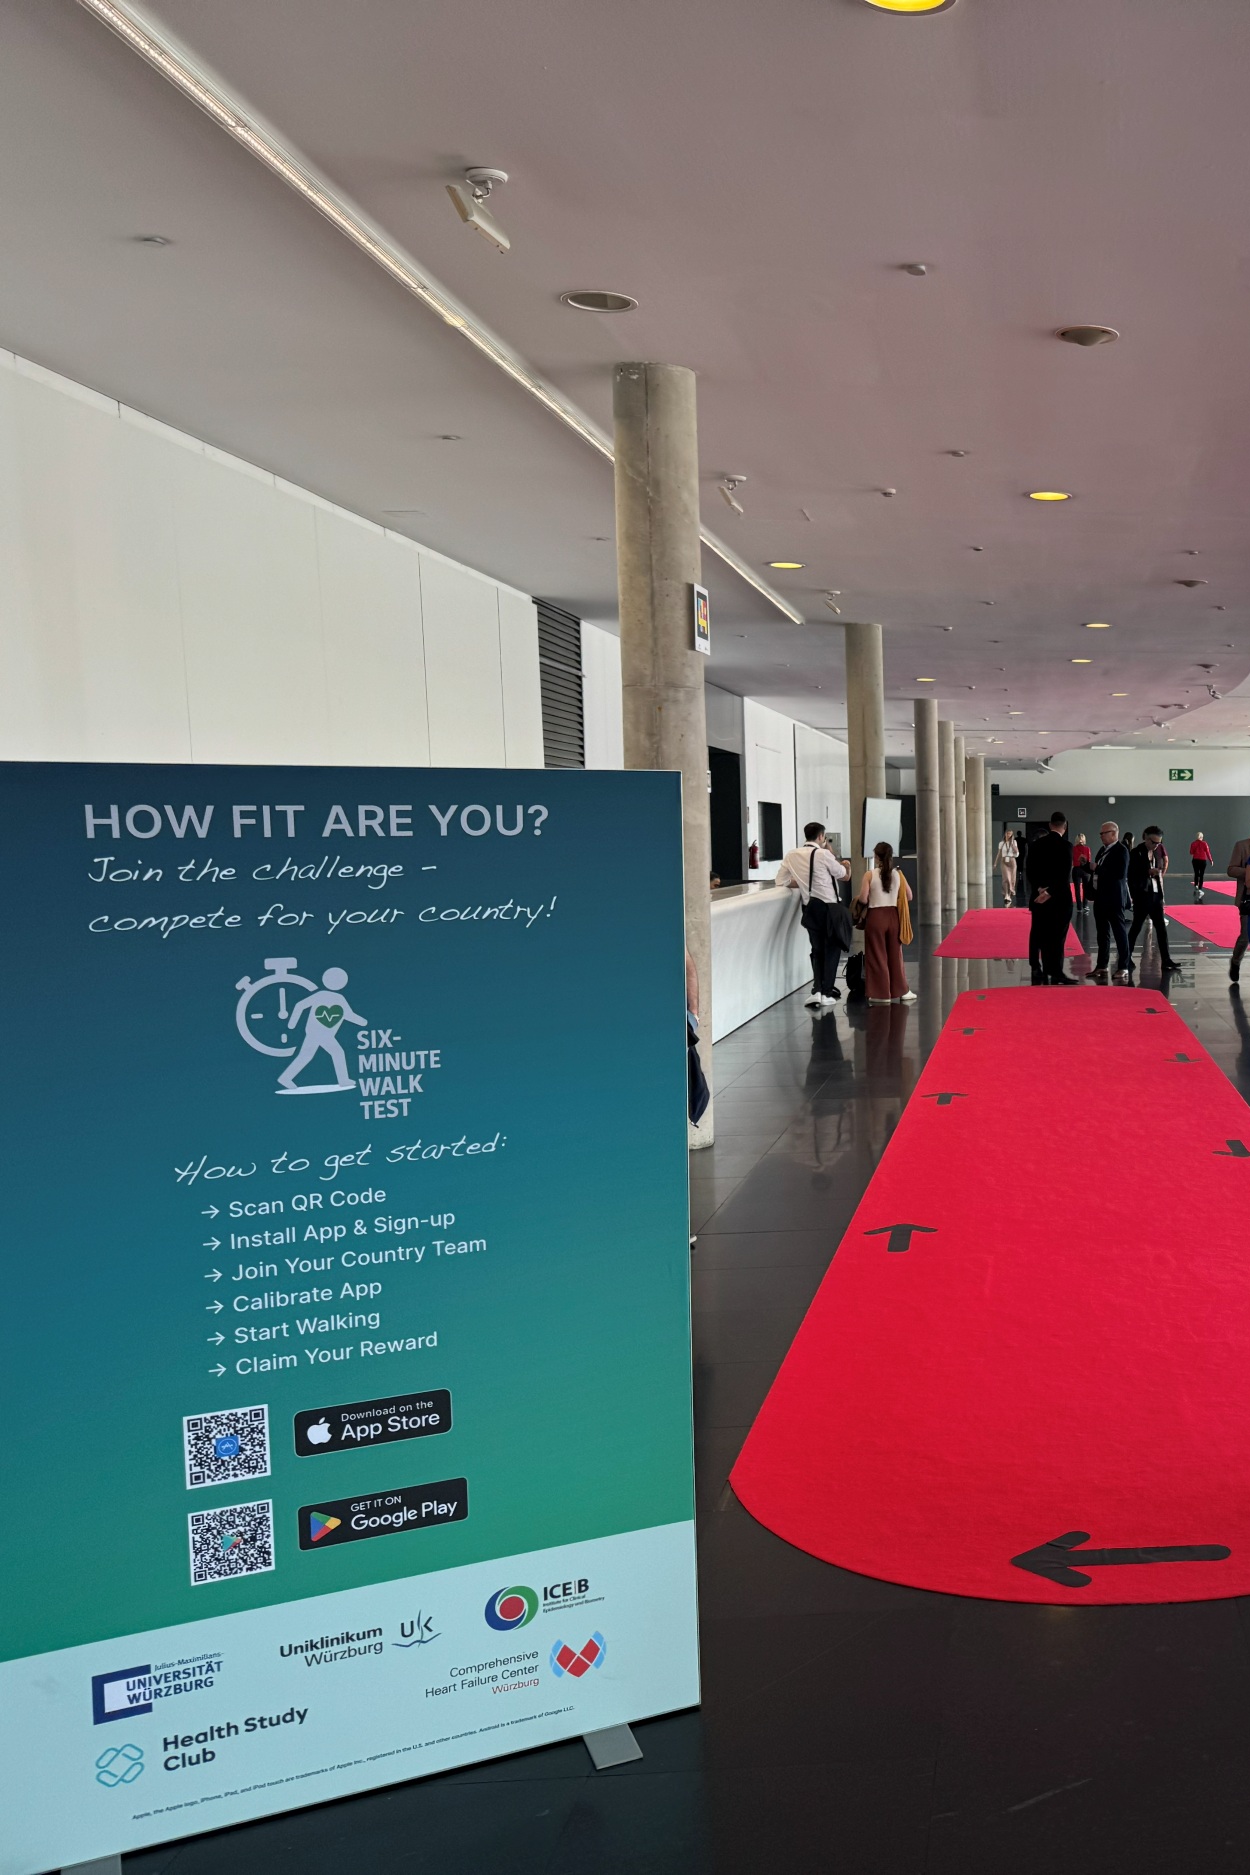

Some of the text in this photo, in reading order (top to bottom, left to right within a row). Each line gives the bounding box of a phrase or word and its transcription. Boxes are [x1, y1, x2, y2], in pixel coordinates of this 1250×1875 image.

[85, 804, 549, 839] HOW FIT ARE YOU?
[88, 856, 164, 883] Join
[177, 858, 238, 883] the
[252, 855, 405, 890] challenge
[88, 895, 558, 939] compete for your country!
[356, 1029, 402, 1050] SIX-
[358, 1049, 441, 1074] MINUTE
[358, 1074, 424, 1097] WALK
[360, 1098, 412, 1120] TEST
[174, 1132, 508, 1186] How to get started:
[228, 1187, 387, 1219] Scan QR Code
[230, 1211, 456, 1250] Install App & Sign-up
[231, 1238, 487, 1282] Join Your Country Team
[232, 1280, 382, 1313] Calibrate App
[234, 1311, 380, 1344] Start Walking
[235, 1331, 438, 1375] Claim Your Reward
[341, 1400, 434, 1422] Download on the
[340, 1413, 441, 1442] App Store
[350, 1495, 402, 1512] GET IT ON
[351, 1500, 458, 1531] Google Play
[543, 1602, 574, 1613] Epidemiology
[279, 1627, 383, 1658] Uniklinikum
[304, 1641, 383, 1667] Würzburg
[126, 1660, 224, 1692] UNIVERSITÄT
[154, 1651, 225, 1673] Julius-Maximilians-
[450, 1650, 539, 1678] Comprehensive
[127, 1676, 214, 1706] WÜRZBURG
[425, 1663, 539, 1698] Heart Failure Center
[491, 1677, 540, 1695] Würzburg
[163, 1707, 309, 1752] Health Study
[163, 1747, 216, 1771] Club
[165, 1803, 183, 1812] Apple
[224, 1789, 239, 1797] iPad,
[240, 1786, 252, 1794] and
[252, 1782, 267, 1791] iPod
[267, 1778, 284, 1787] touch
[295, 1767, 328, 1780] trademarks
[336, 1761, 353, 1769] Apple
[366, 1750, 395, 1762] registered
[435, 1736, 451, 1744] other
[451, 1730, 477, 1740] countries.
[479, 1723, 500, 1733] Android
[510, 1714, 537, 1725] trademark
[544, 1709, 563, 1717] Google
